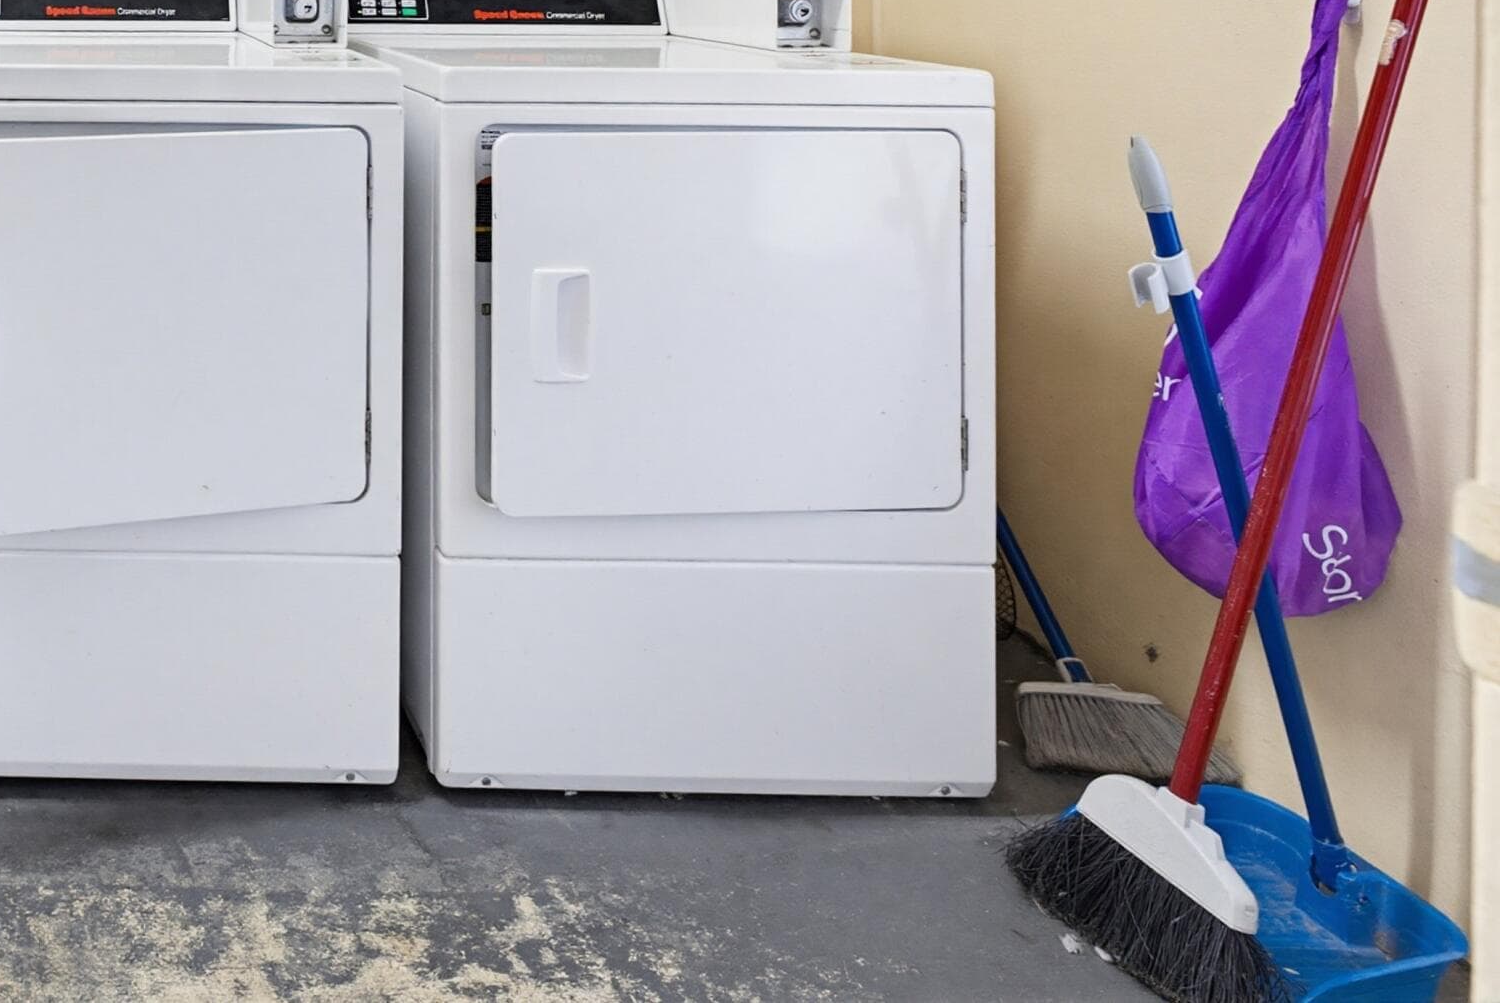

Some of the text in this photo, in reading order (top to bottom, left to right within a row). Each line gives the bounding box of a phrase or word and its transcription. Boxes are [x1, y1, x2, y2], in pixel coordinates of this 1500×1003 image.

[117, 6, 156, 15] Commercial
[157, 6, 176, 16] Dryer
[546, 11, 585, 19] Commercial
[586, 11, 606, 20] Dryer
